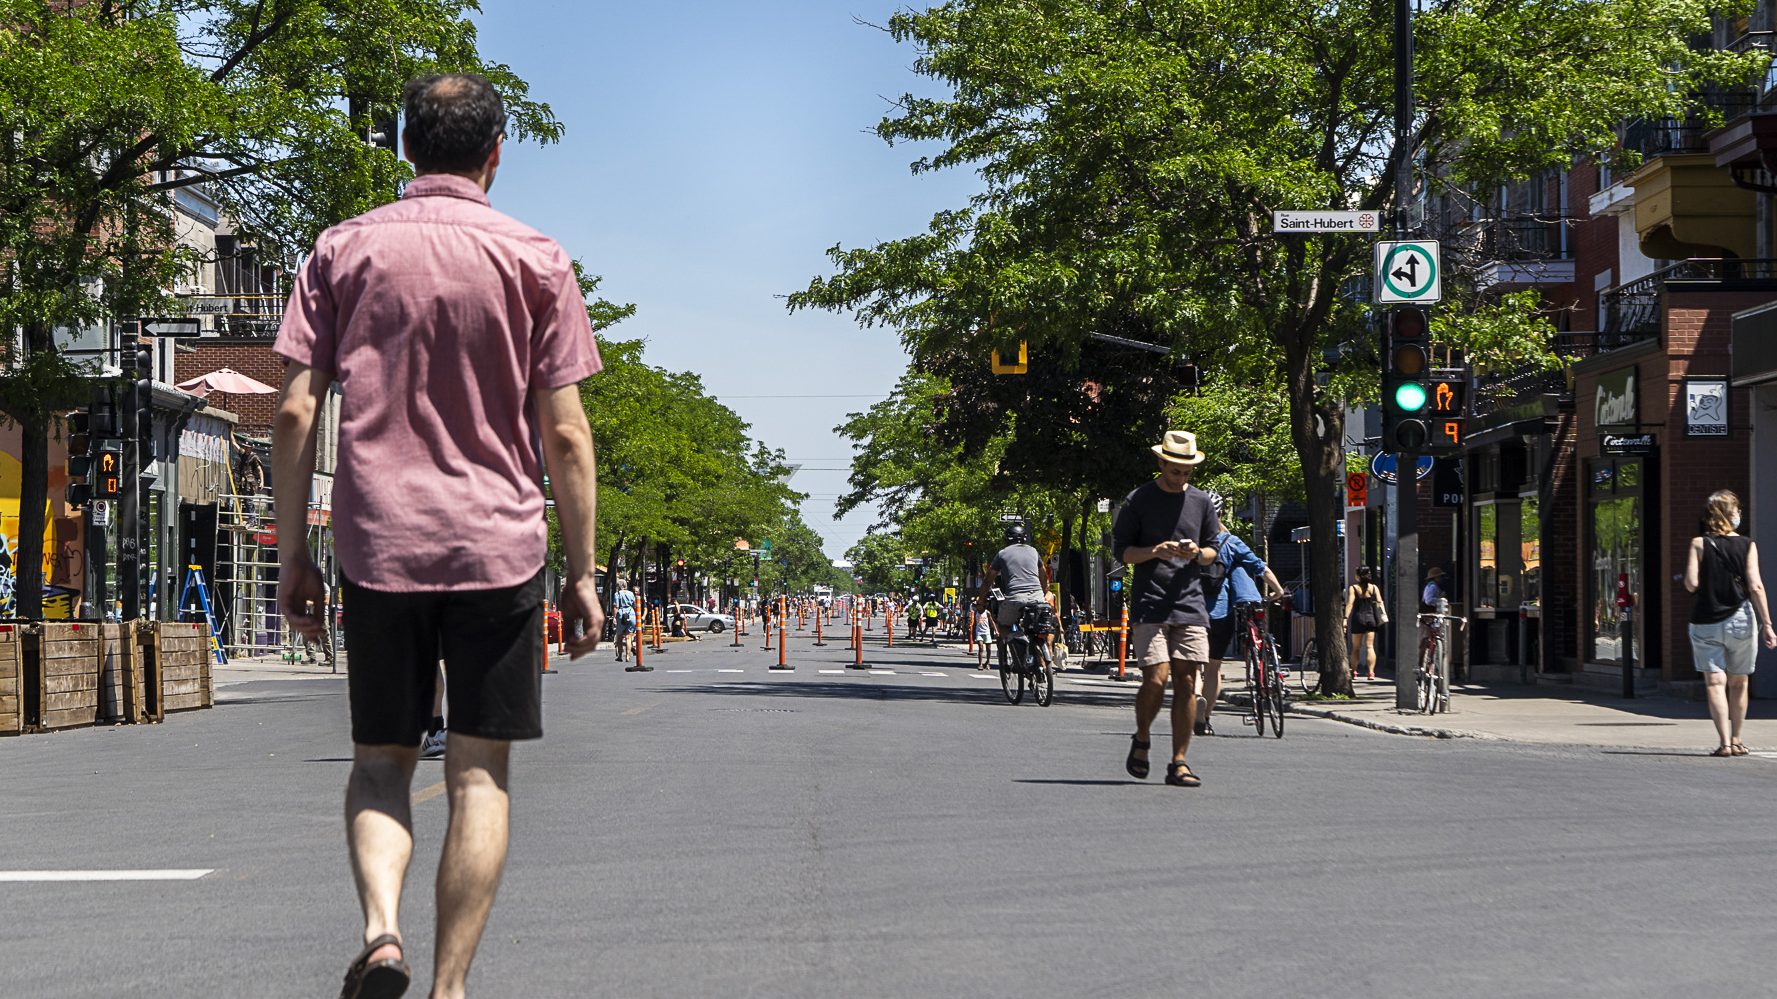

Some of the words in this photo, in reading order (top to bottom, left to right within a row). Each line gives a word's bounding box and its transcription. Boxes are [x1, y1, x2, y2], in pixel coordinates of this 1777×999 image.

[1280, 218, 1354, 229] Saint-Hubert
[172, 303, 228, 312] St-Hubert
[1445, 421, 1458, 444] 9
[1688, 424, 1727, 433] DENTISTE
[107, 478, 117, 493] 0
